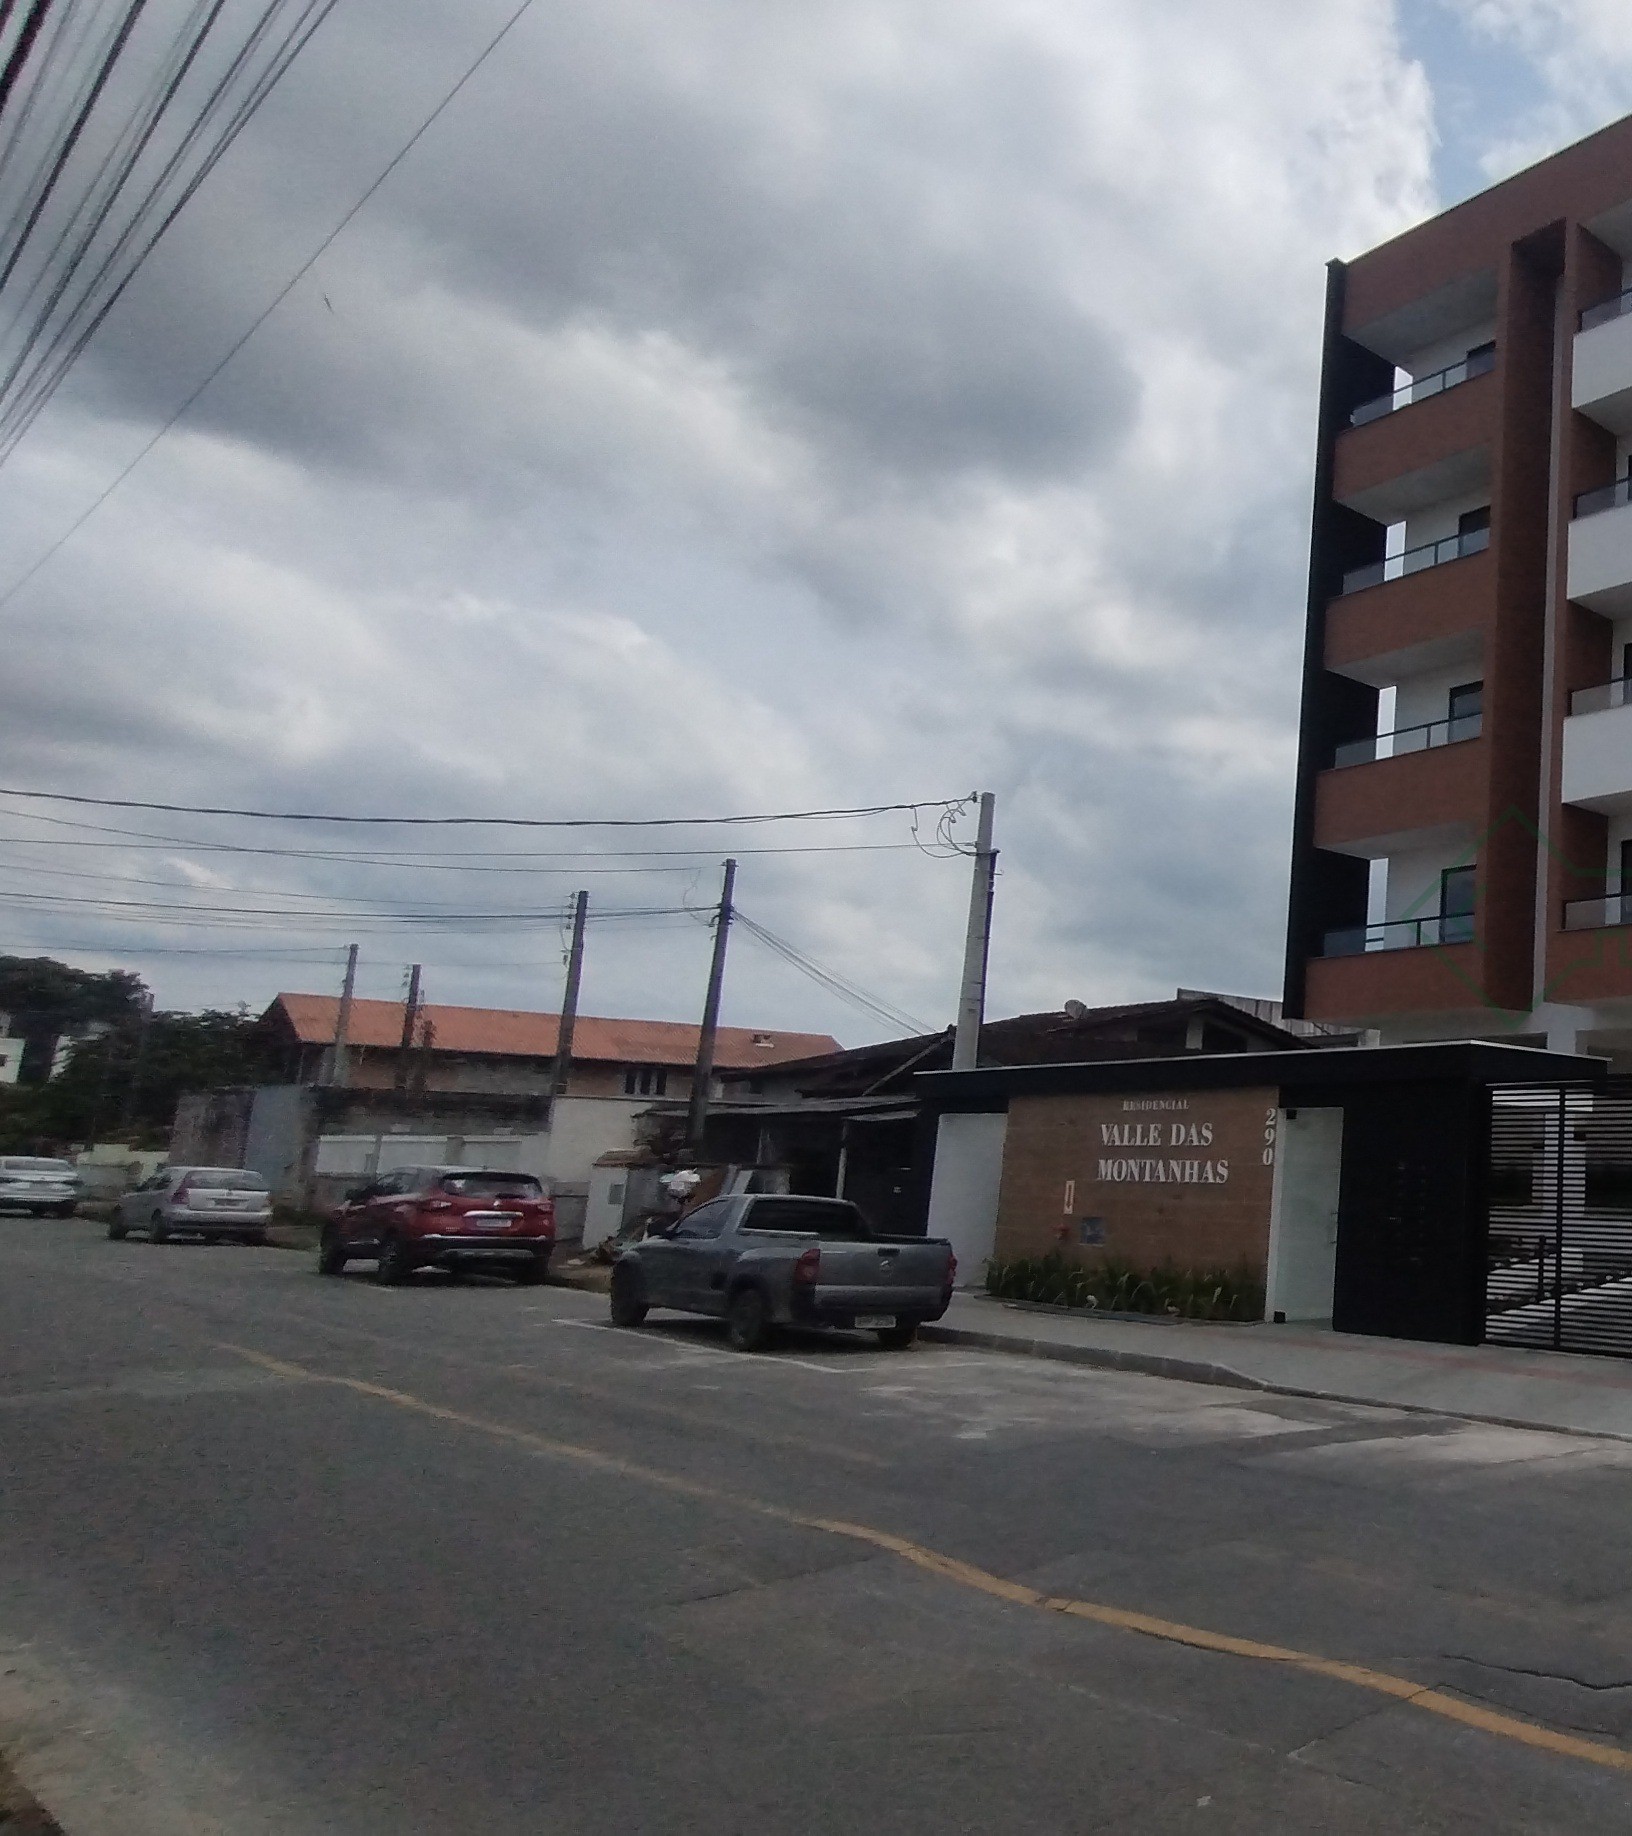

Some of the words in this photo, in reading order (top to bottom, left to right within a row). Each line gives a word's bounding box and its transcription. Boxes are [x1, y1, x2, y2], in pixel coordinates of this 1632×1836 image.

[1122, 1099, 1190, 1111] RESIDENCIAL
[1100, 1124, 1161, 1147] VALLE
[1170, 1122, 1214, 1147] DAS
[1262, 1108, 1277, 1167] 290
[1097, 1159, 1229, 1184] MONTANHAS
